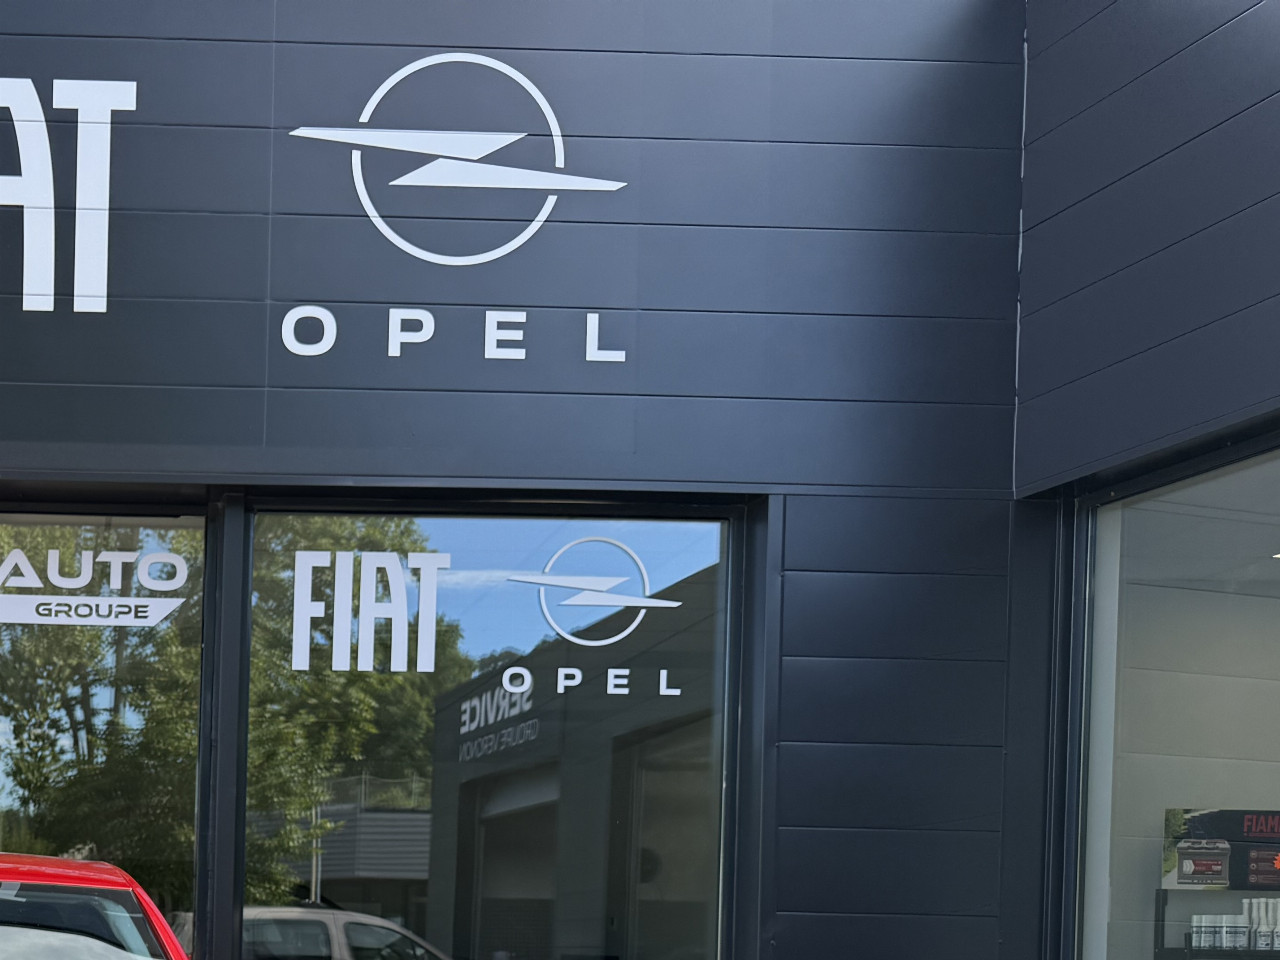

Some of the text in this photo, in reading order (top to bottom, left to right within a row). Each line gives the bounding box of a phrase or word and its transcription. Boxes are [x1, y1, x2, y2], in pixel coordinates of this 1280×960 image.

[281, 305, 626, 362] OPEL
[35, 602, 149, 620] GROUPE
[291, 551, 451, 673] FIAT
[502, 666, 681, 696] OPEL
[1243, 814, 1280, 832] FIAM
